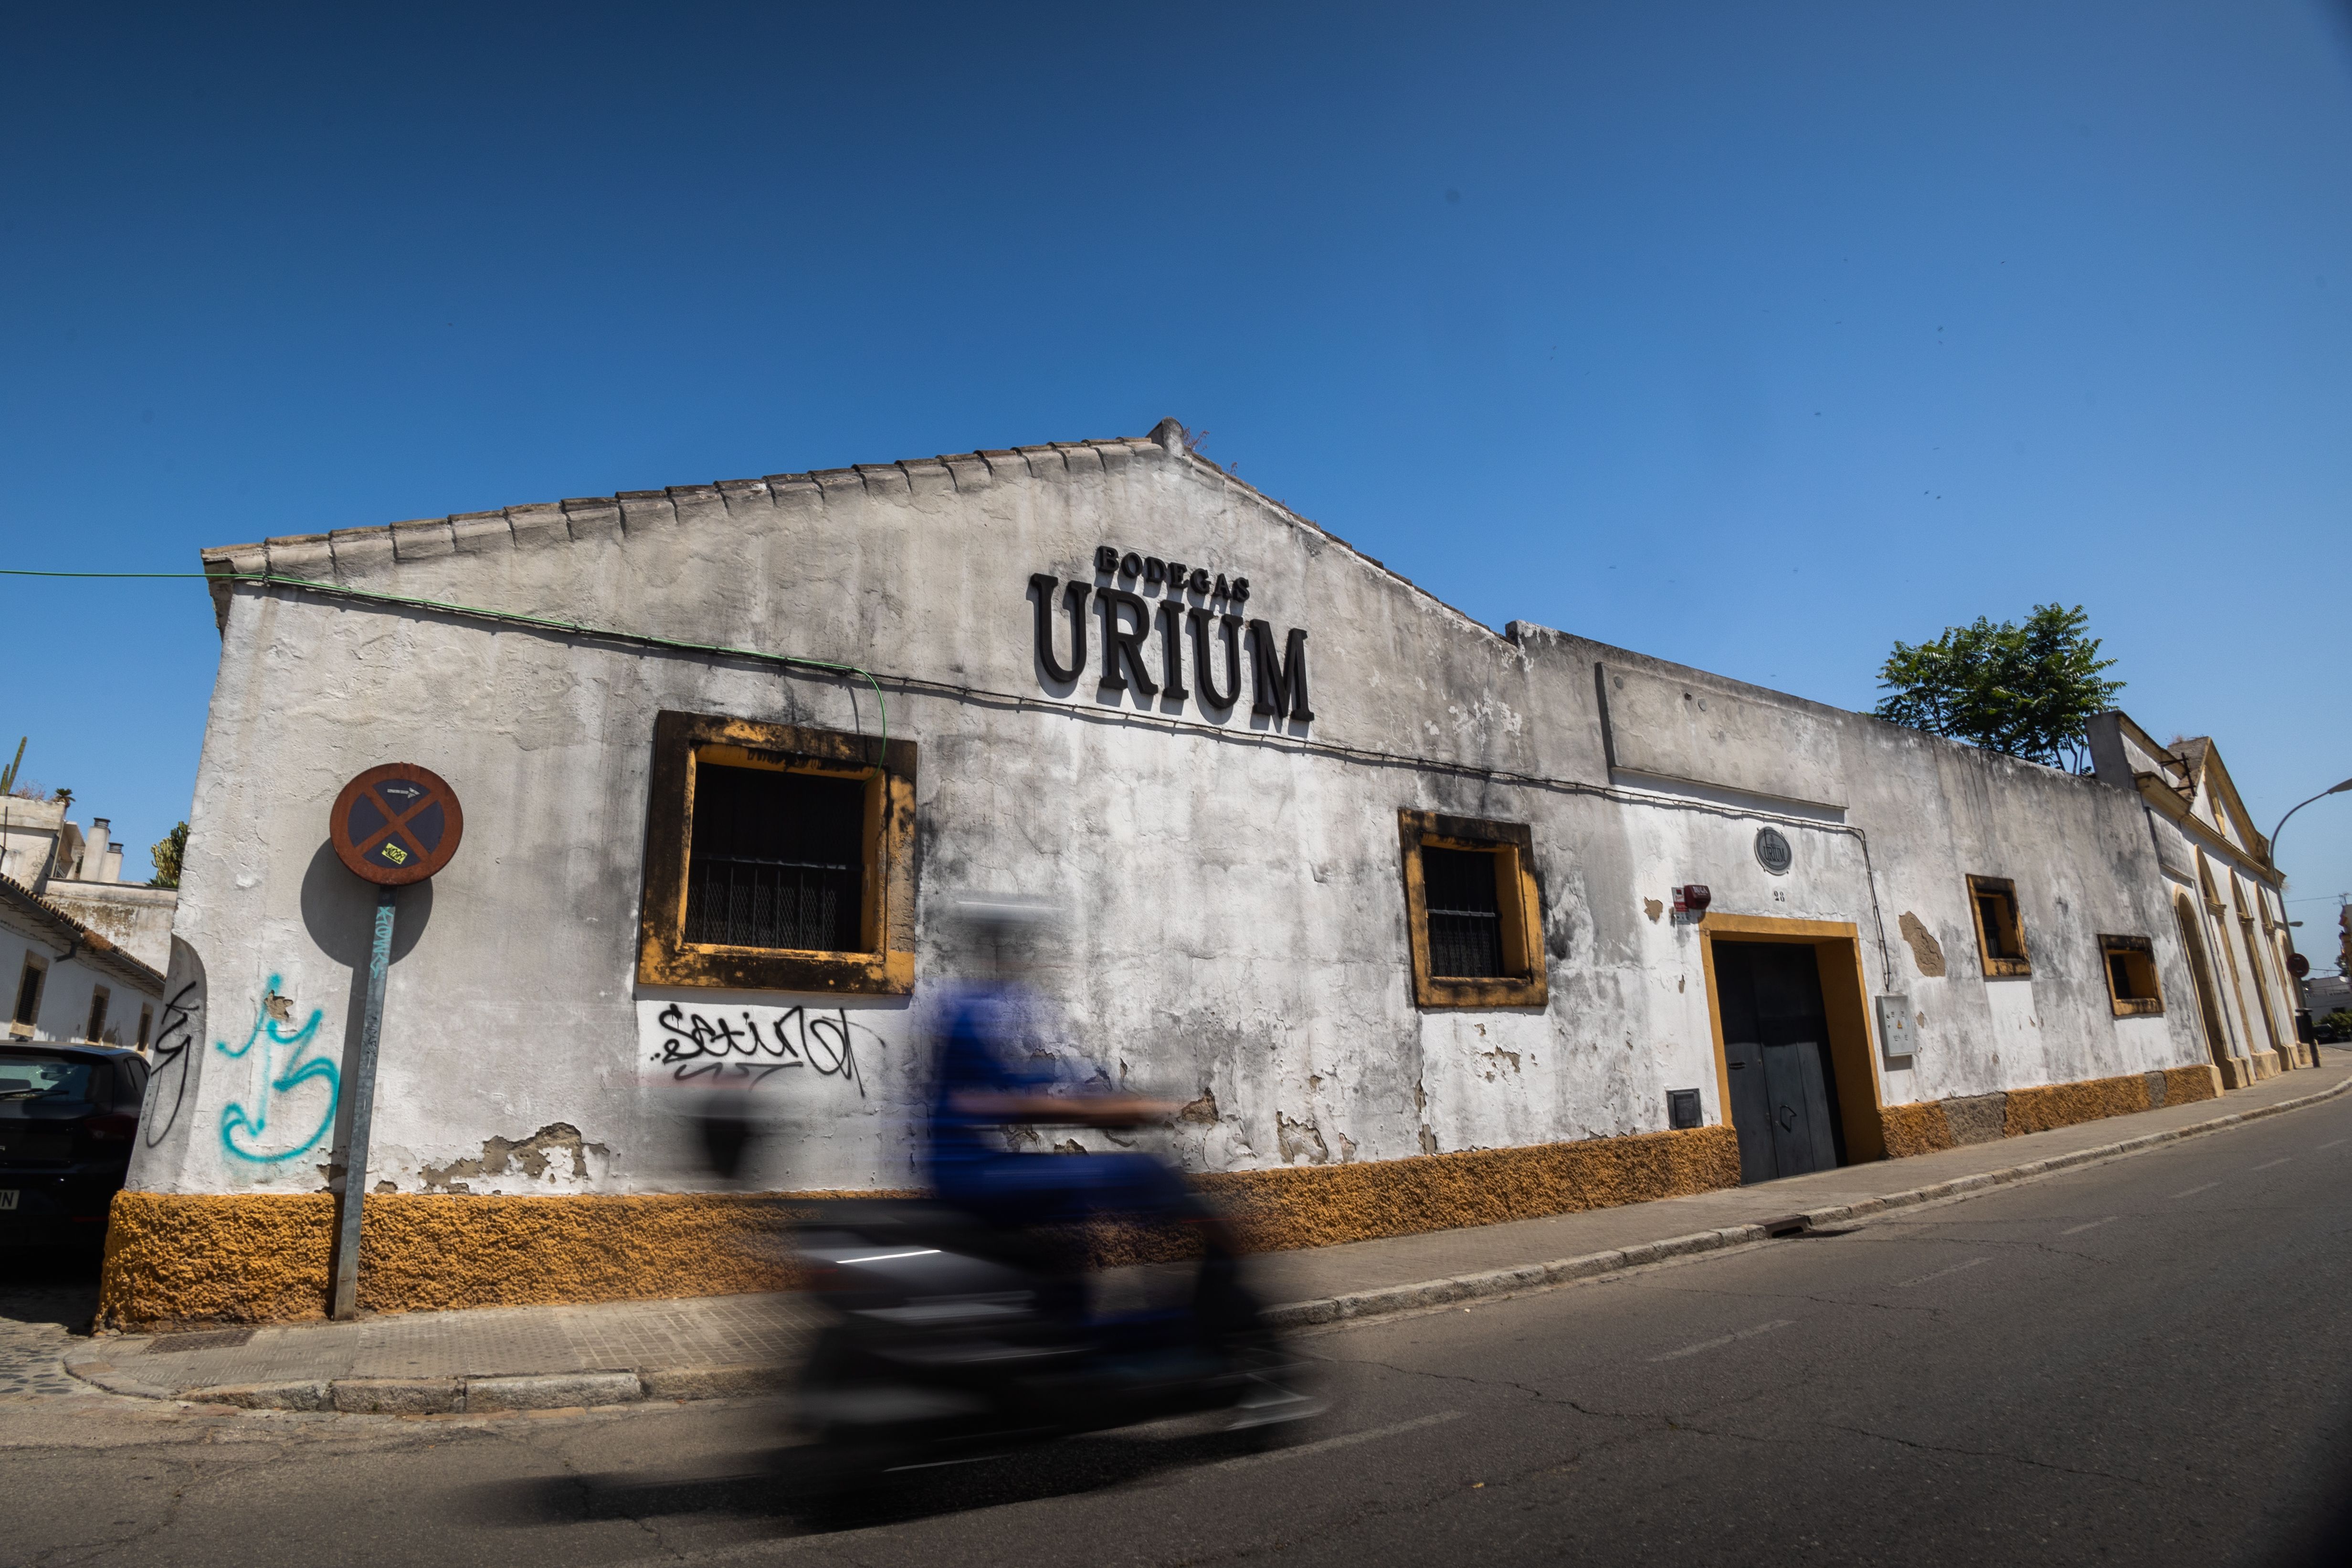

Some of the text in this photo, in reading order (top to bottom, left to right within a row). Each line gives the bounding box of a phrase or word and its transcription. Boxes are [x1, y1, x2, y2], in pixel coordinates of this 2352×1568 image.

[1097, 546, 1250, 602] BODEGAS
[1030, 573, 1315, 722] URIUM
[1763, 846, 1786, 862] URIUM
[0, 1192, 14, 1207] N
